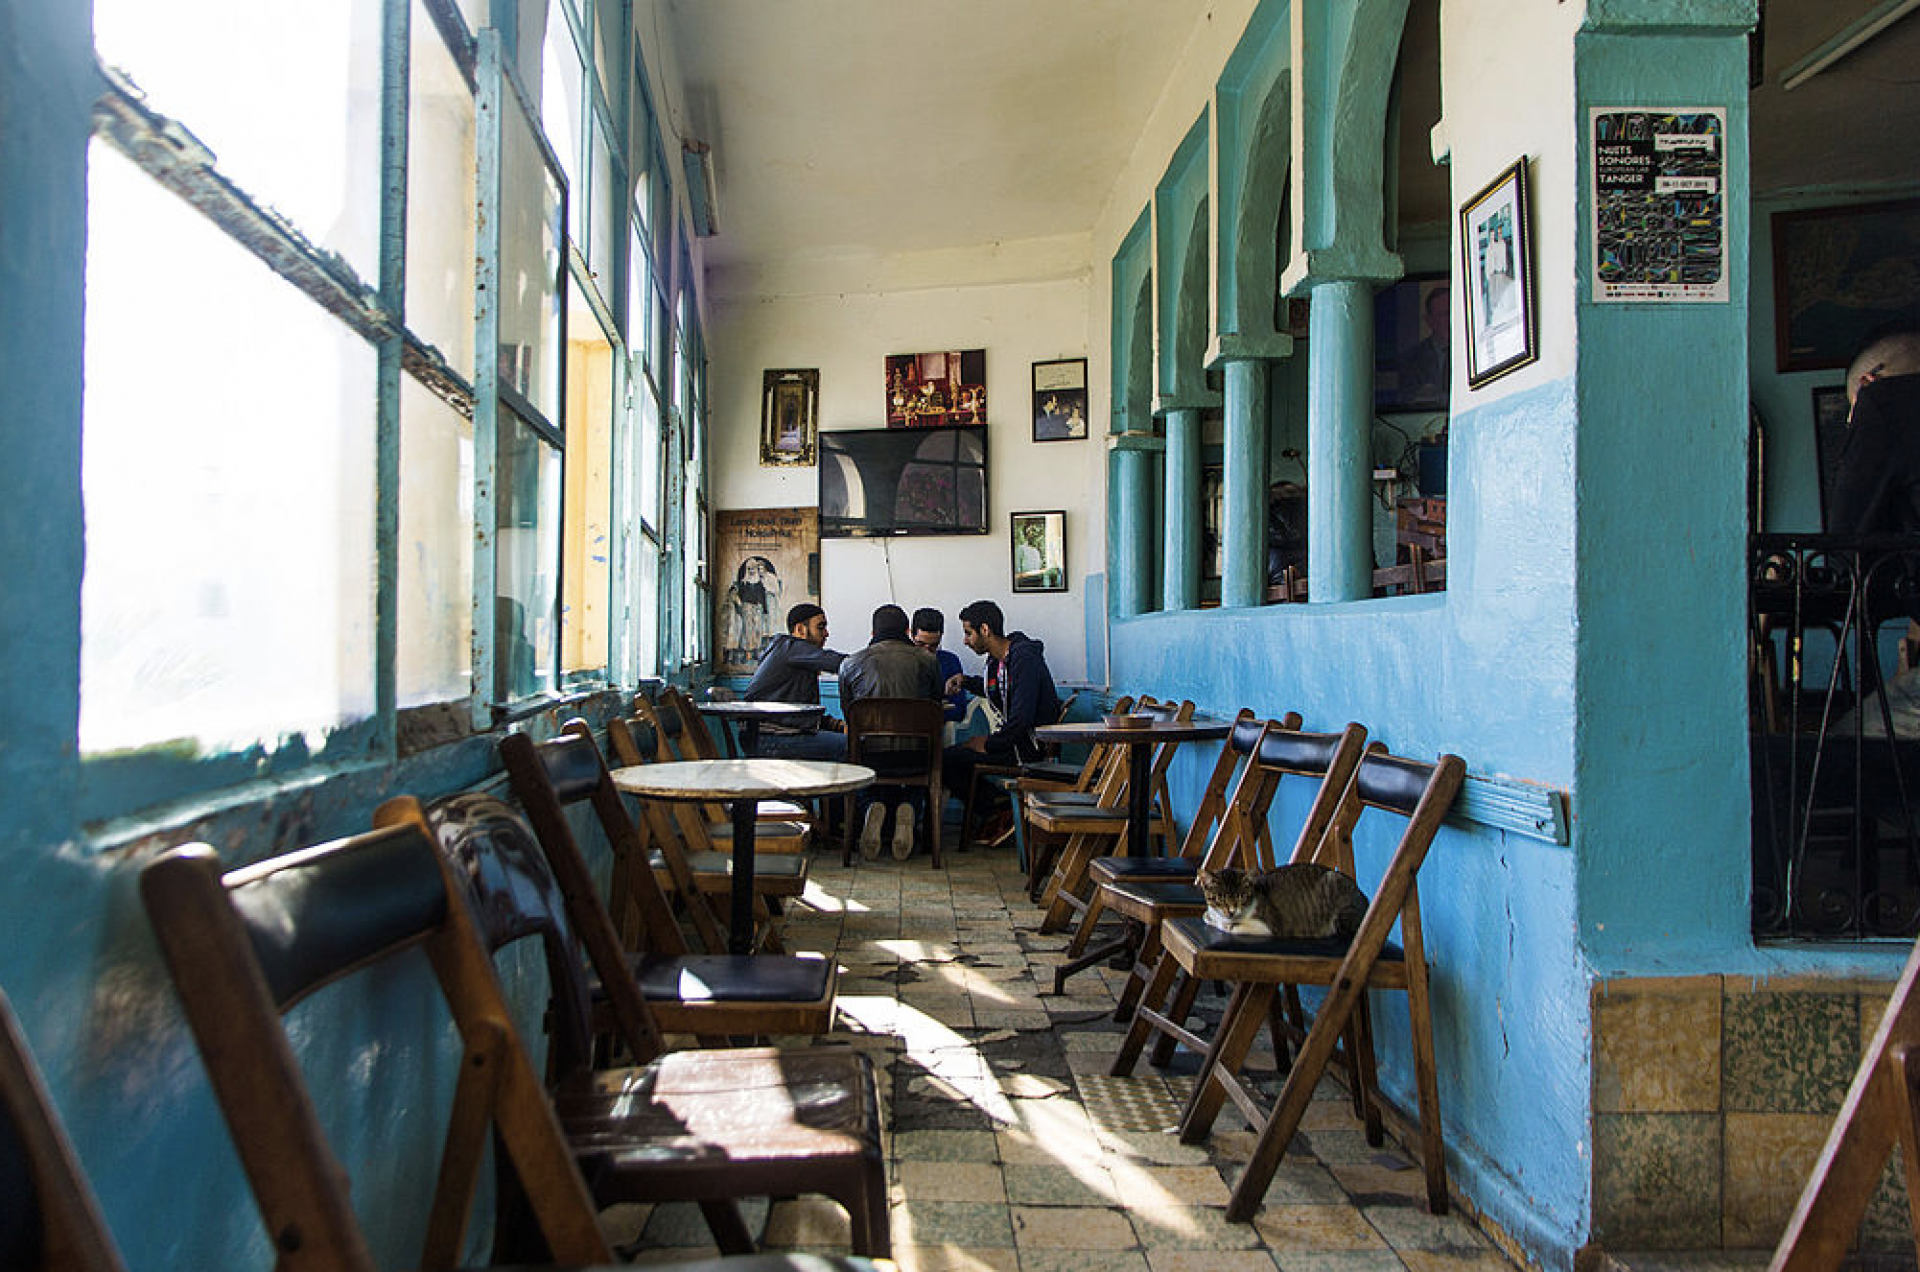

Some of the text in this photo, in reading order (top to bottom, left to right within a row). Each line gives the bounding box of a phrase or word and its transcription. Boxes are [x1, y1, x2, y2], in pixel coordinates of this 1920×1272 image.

[1598, 145, 1633, 155] NUITS
[1598, 155, 1651, 166] SONORES
[1599, 174, 1644, 183] TANGER
